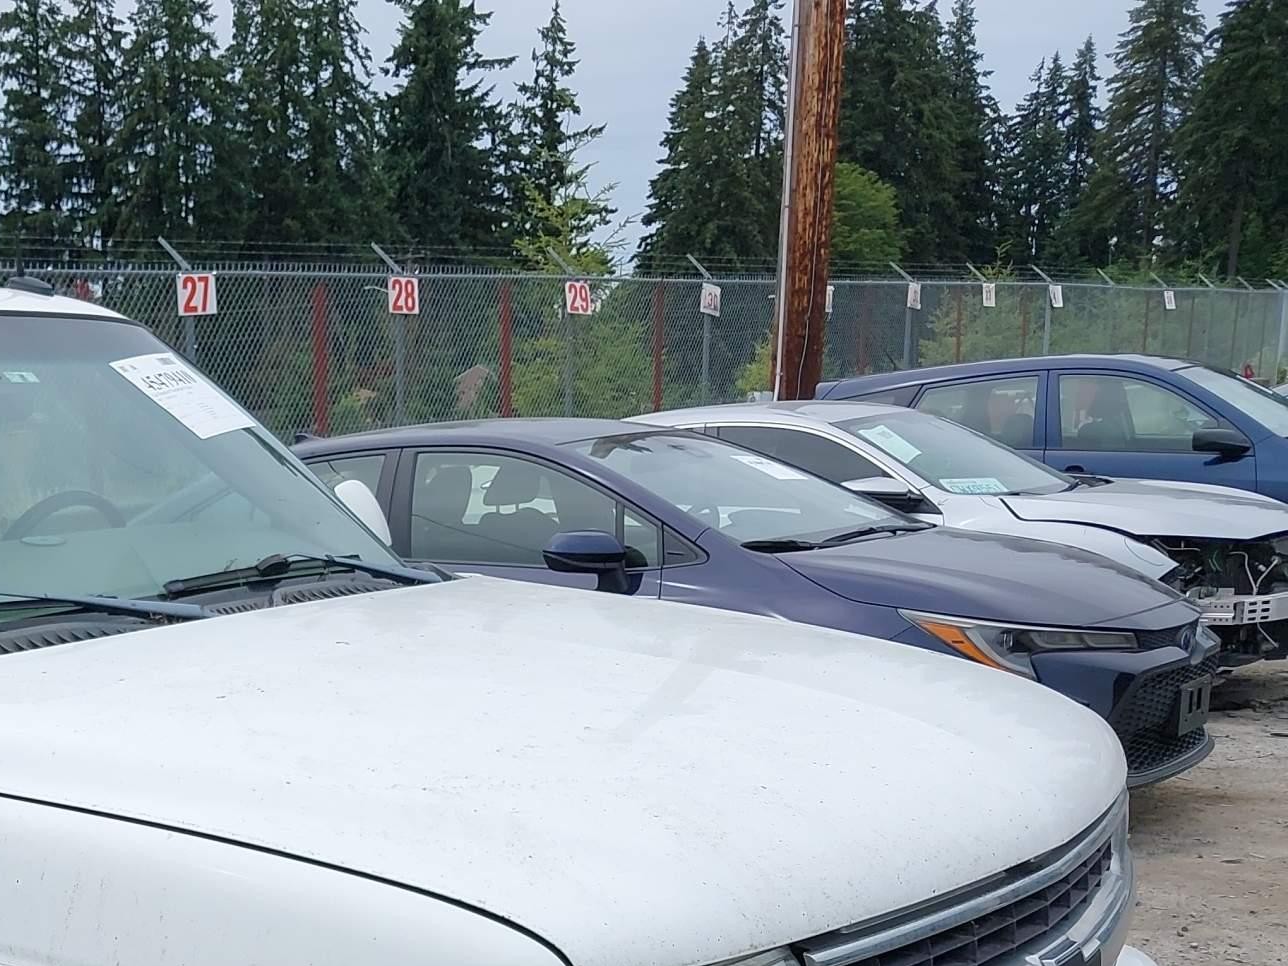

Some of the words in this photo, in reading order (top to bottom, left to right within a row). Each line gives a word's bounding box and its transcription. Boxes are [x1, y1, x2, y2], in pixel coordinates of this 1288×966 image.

[182, 275, 209, 313] 27
[392, 278, 415, 312] 28
[568, 283, 589, 313] 29
